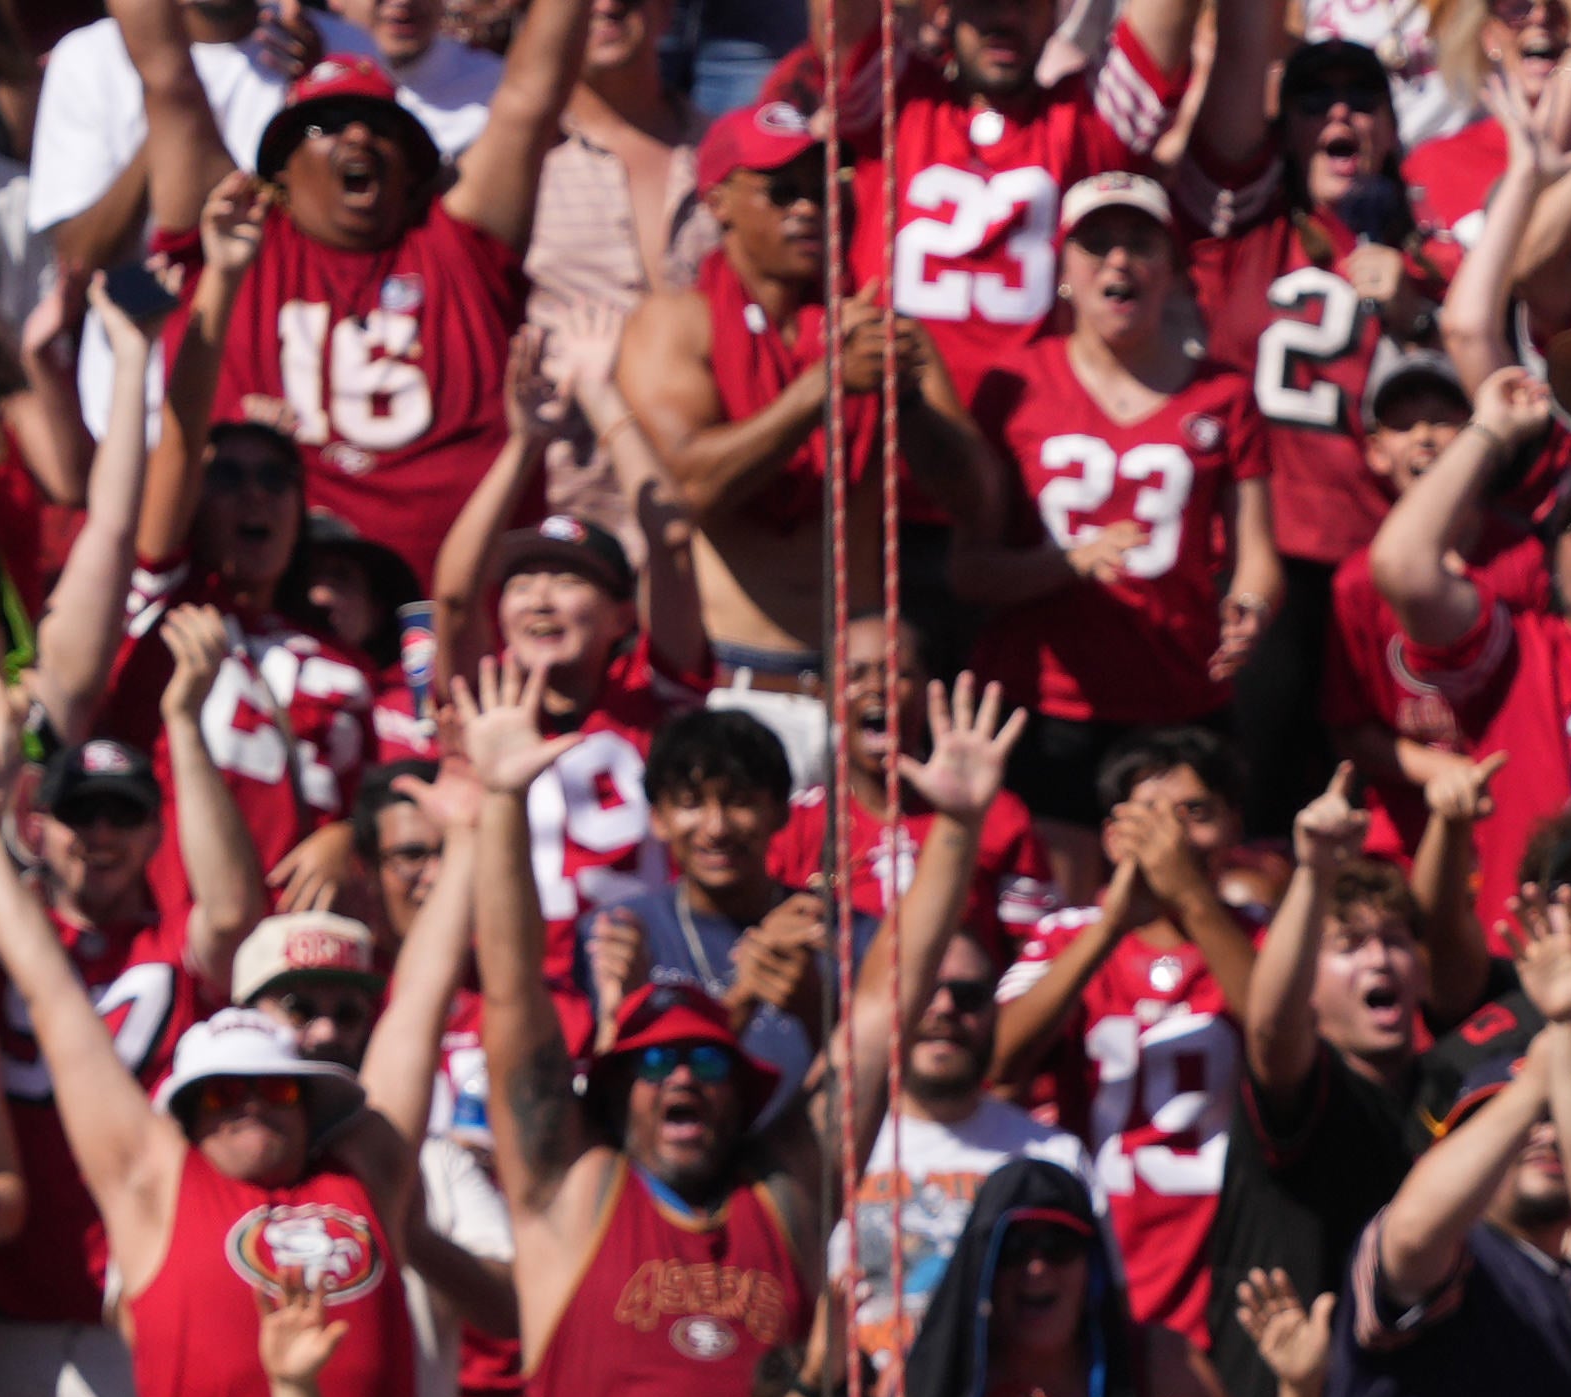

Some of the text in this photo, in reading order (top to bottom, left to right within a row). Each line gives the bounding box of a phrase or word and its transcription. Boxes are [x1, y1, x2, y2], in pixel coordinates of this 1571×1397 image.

[894, 164, 1059, 323] 23
[278, 300, 431, 451] 16
[1039, 433, 1194, 579] 23
